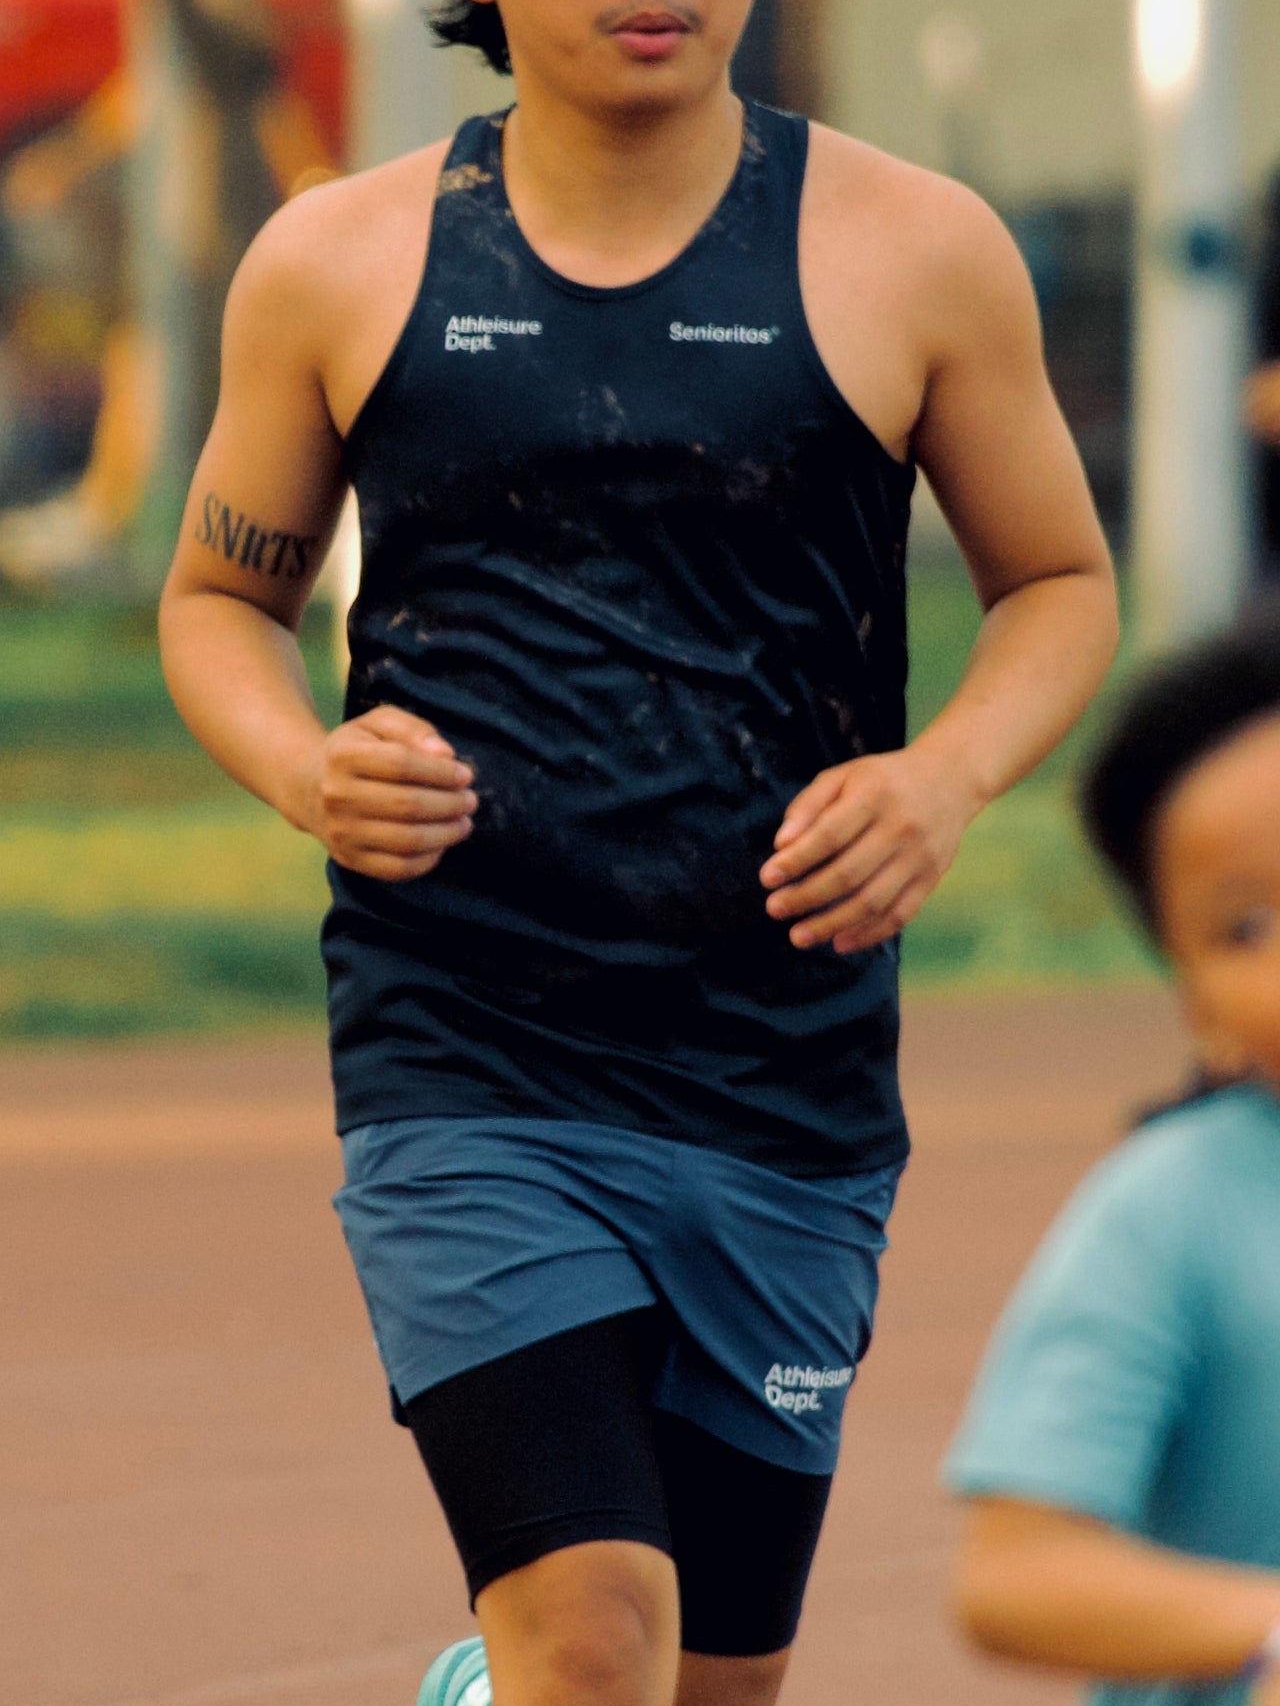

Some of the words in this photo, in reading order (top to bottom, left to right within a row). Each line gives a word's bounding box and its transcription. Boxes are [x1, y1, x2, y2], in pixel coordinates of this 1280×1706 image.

[446, 315, 543, 335] Athleisure
[445, 333, 496, 353] Dept.
[764, 1385, 822, 1415] Dept.
